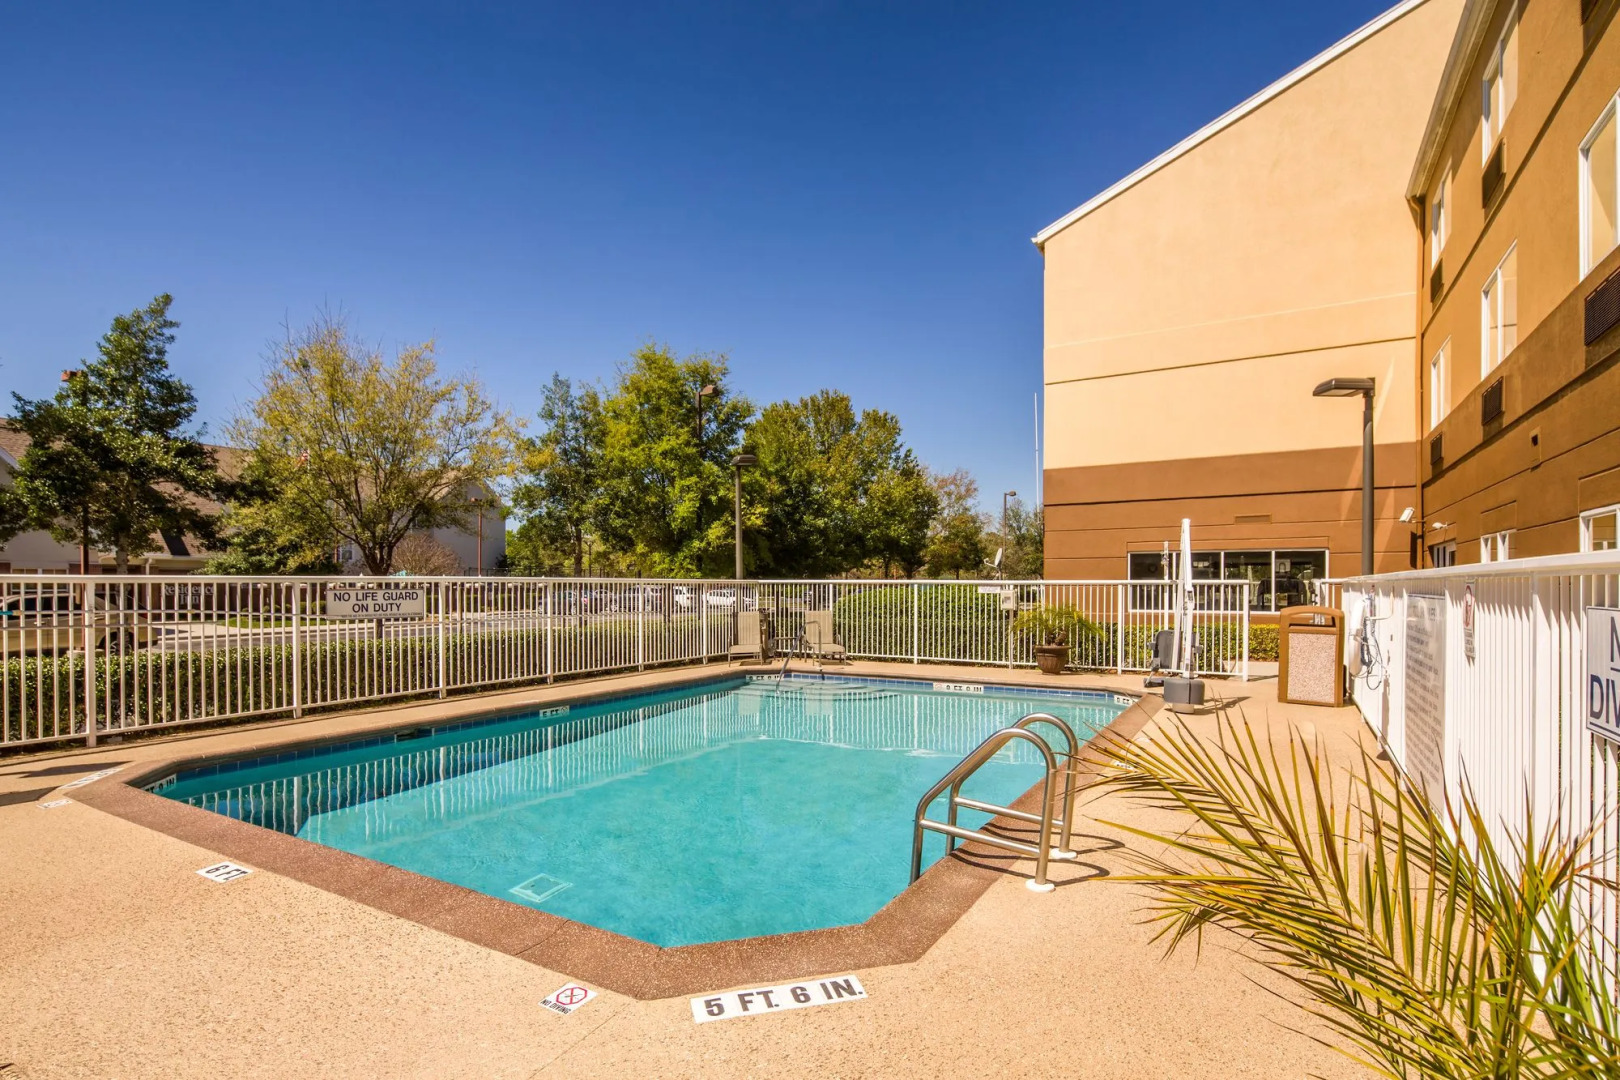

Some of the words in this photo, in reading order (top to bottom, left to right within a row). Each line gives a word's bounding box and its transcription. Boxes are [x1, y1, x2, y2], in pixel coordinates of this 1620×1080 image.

[161, 584, 216, 596] Reidence
[333, 592, 351, 602] NO
[355, 592, 378, 601] LIFE
[382, 591, 419, 601] GUARD
[352, 603, 369, 613] ON
[373, 602, 402, 612] DUTY
[703, 997, 726, 1017] 5
[737, 989, 780, 1012] FT.
[789, 986, 812, 1004] 6
[819, 978, 864, 1000] IN.
[549, 1002, 572, 1015] DIVING
